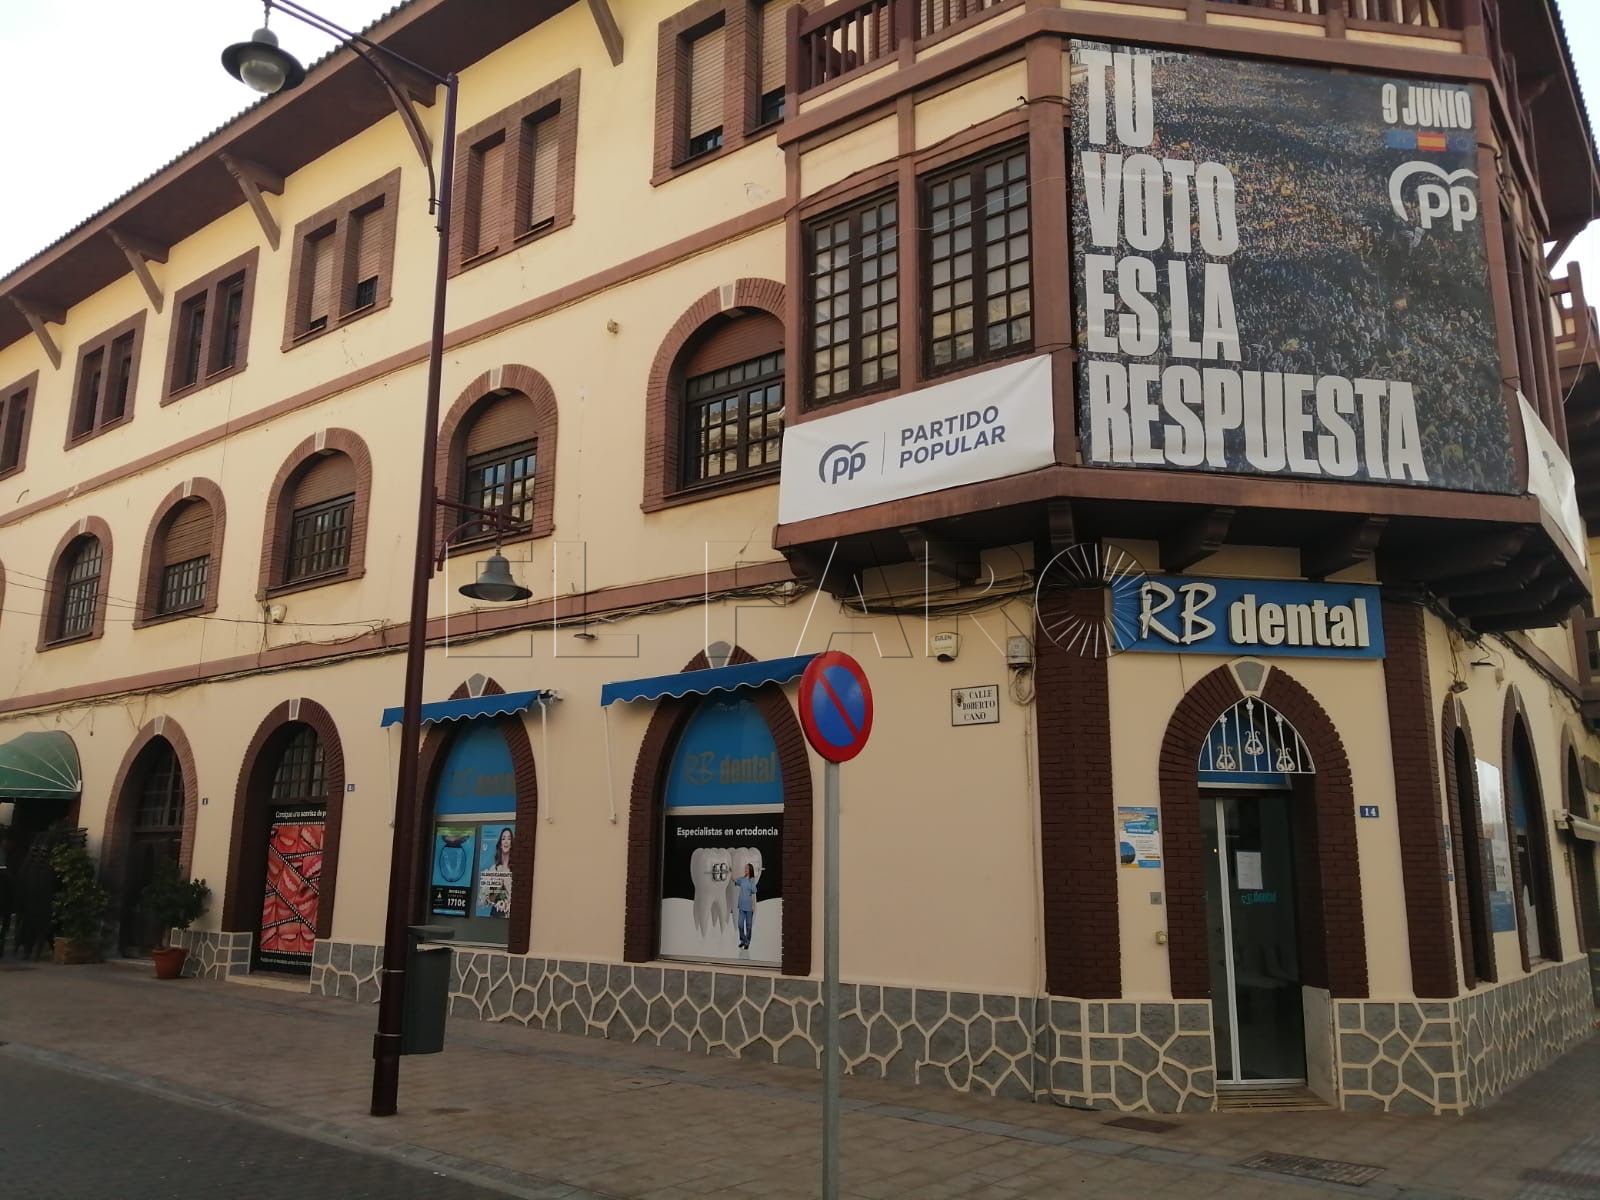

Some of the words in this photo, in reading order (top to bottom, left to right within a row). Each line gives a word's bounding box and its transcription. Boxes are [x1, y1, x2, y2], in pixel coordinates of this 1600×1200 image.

[1080, 50, 1154, 148] TU
[1382, 83, 1398, 124] 9
[1402, 86, 1472, 129] JUNIO
[1081, 151, 1239, 257] VOTO
[1084, 253, 1160, 357] ES
[1168, 259, 1242, 362] LA
[900, 405, 999, 447] PARTIDO
[1088, 359, 1430, 482] RESPUESTA
[899, 425, 1006, 469] POPULAR
[1139, 580, 1217, 645] RB
[1228, 593, 1371, 648] dental
[962, 700, 996, 711] ROBERTO
[969, 689, 993, 699] CALLE
[964, 712, 986, 721] CANO
[719, 751, 777, 785] dental
[676, 827, 723, 838] Especialistas
[724, 828, 734, 836] en
[735, 826, 779, 836] ortodoncia
[1364, 807, 1378, 817] 14
